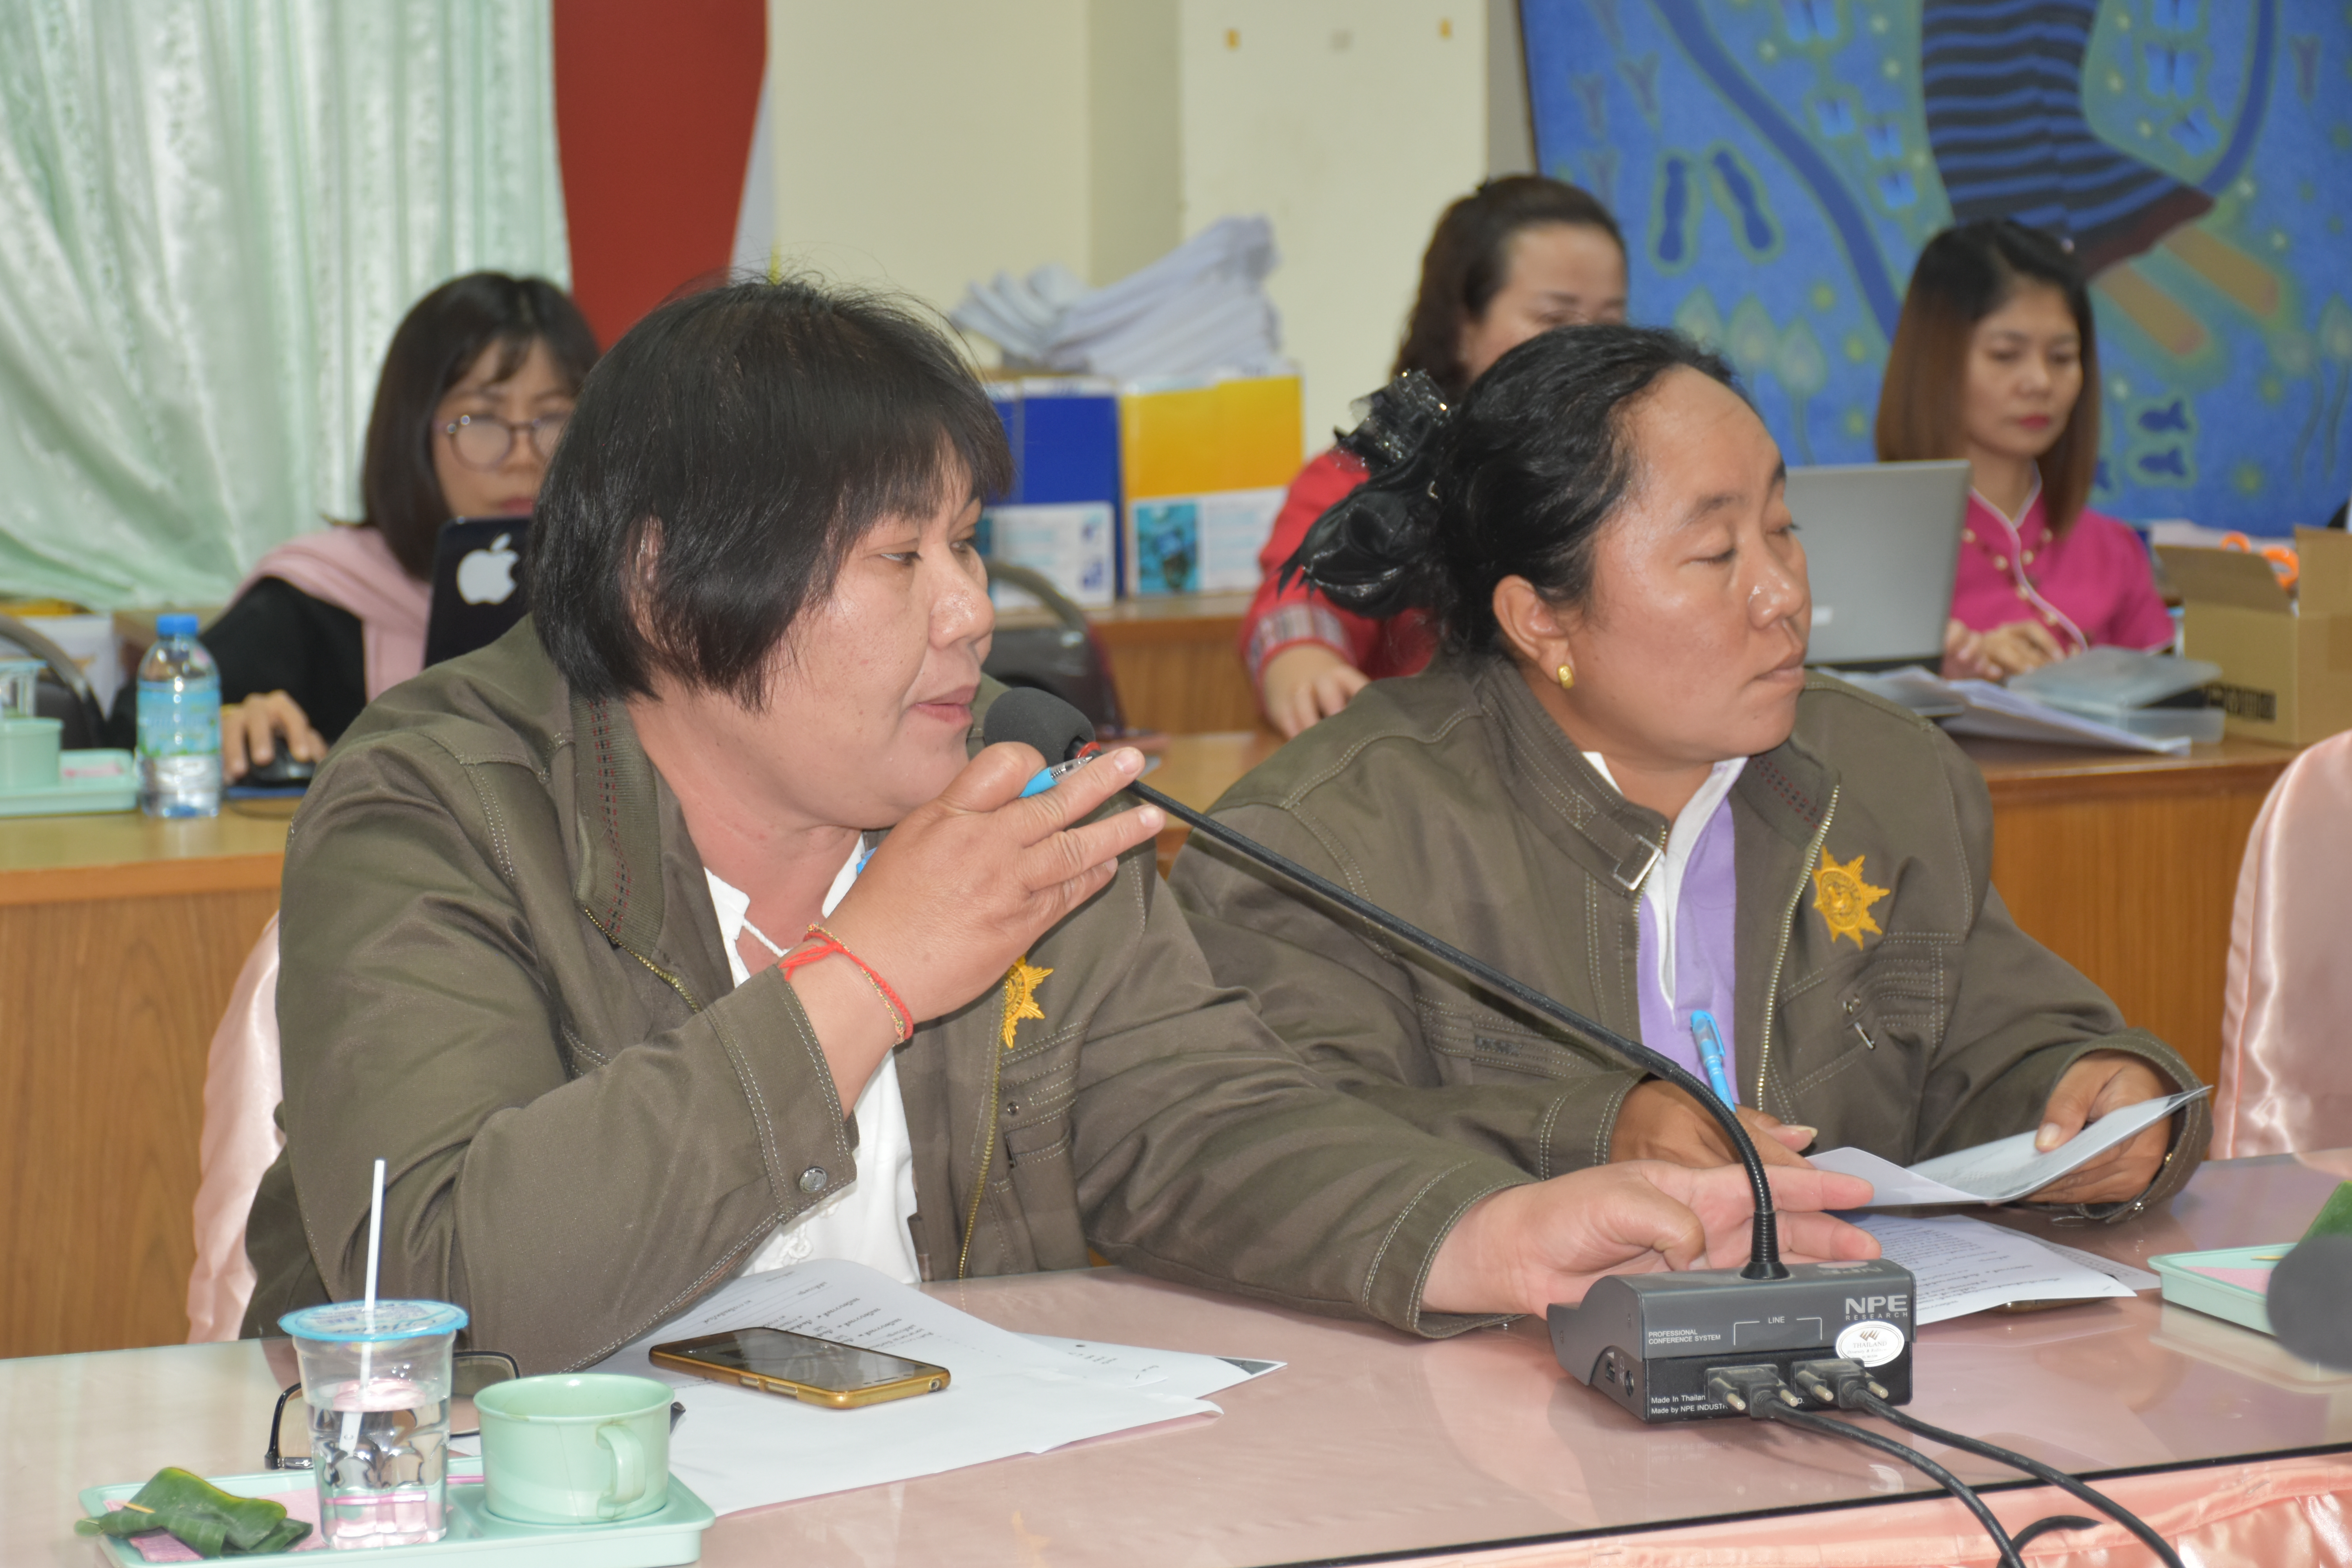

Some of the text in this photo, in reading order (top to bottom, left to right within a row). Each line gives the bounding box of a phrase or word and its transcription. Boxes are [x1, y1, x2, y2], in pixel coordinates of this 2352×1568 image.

[1846, 1295, 1907, 1314] NPE
[1846, 1312, 1907, 1321] RESEARCH
[1649, 1329, 1698, 1338] PROFESSIONAL
[1949, 1479, 1984, 1514] PERFORMANCE
[1988, 1520, 2010, 1551] COMPUTER
